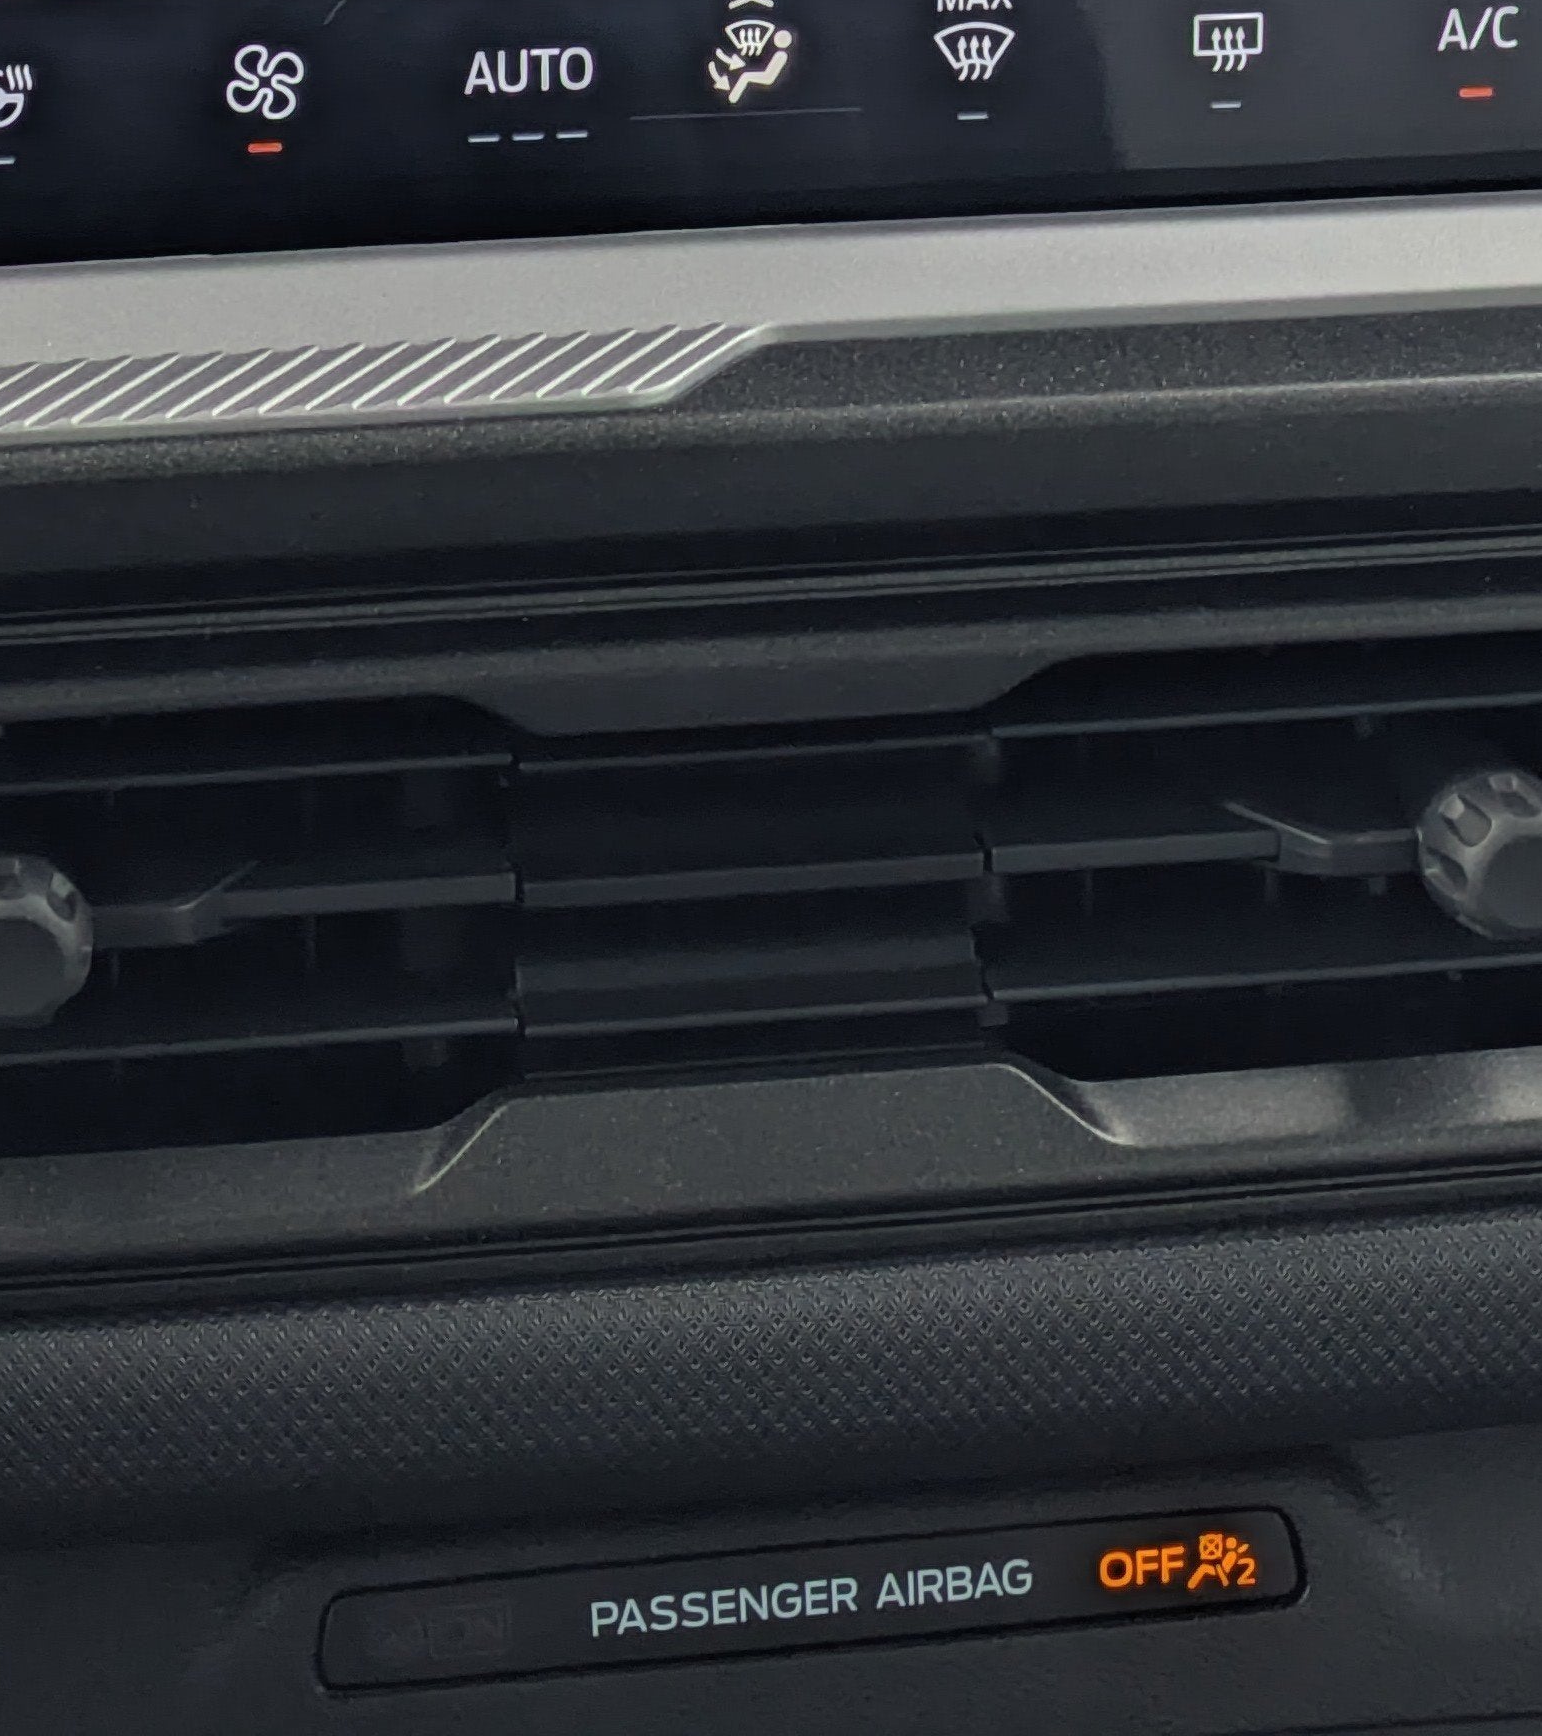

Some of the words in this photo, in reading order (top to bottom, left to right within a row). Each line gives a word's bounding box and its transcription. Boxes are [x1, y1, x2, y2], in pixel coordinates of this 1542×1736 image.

[1437, 5, 1519, 52] A/C
[463, 46, 594, 95] AUTO
[1099, 1545, 1185, 1588] OFF
[590, 1577, 858, 1637] PASSENGER
[876, 1558, 1033, 1609] AIRBAG
